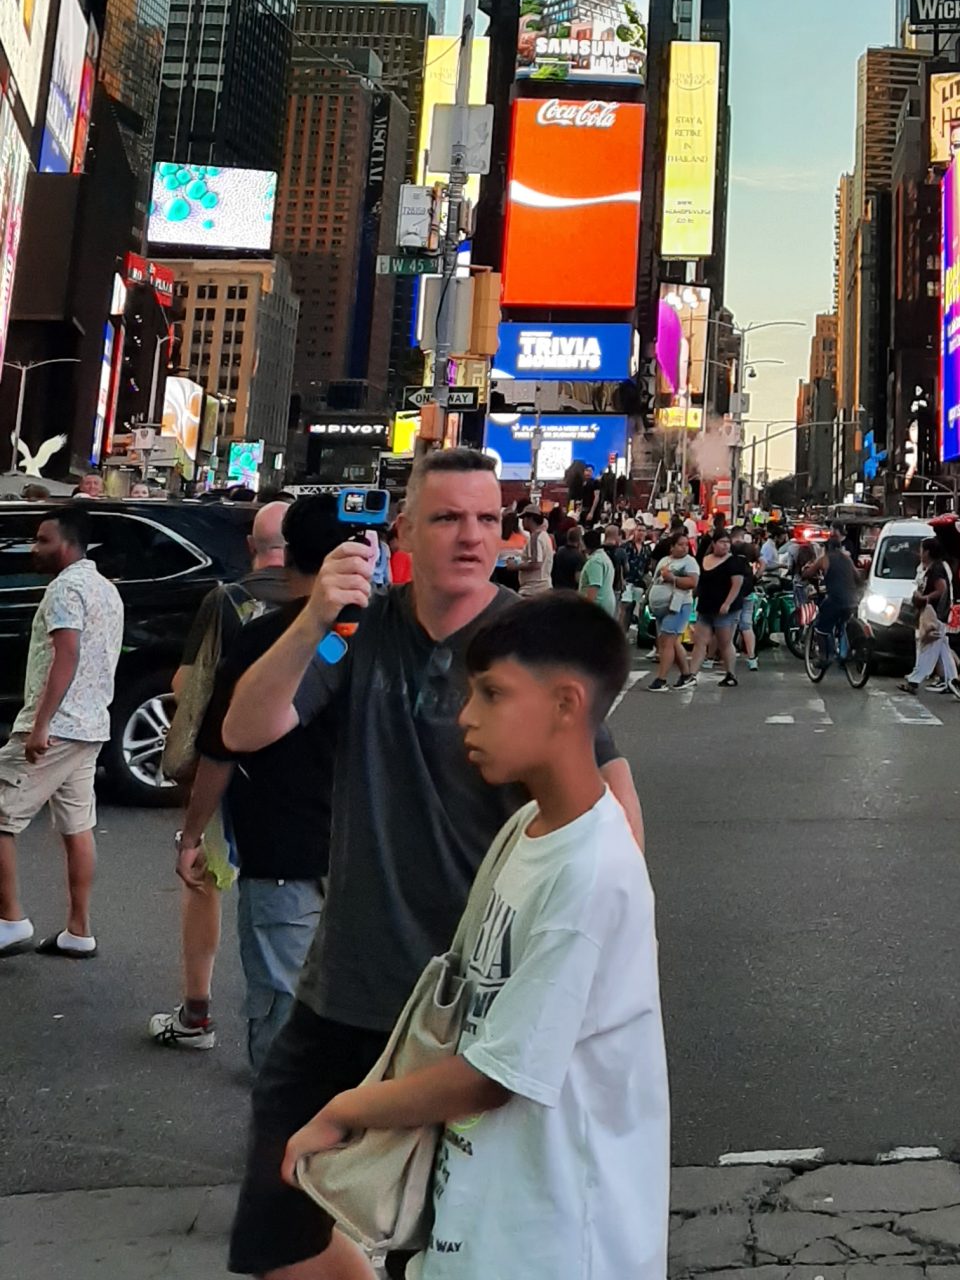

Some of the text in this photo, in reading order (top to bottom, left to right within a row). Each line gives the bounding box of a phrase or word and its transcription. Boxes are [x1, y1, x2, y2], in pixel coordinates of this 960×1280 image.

[391, 258, 403, 272] W
[409, 259, 425, 272] 45
[519, 336, 602, 355] TRIVIA
[435, 1238, 463, 1253] WAY
